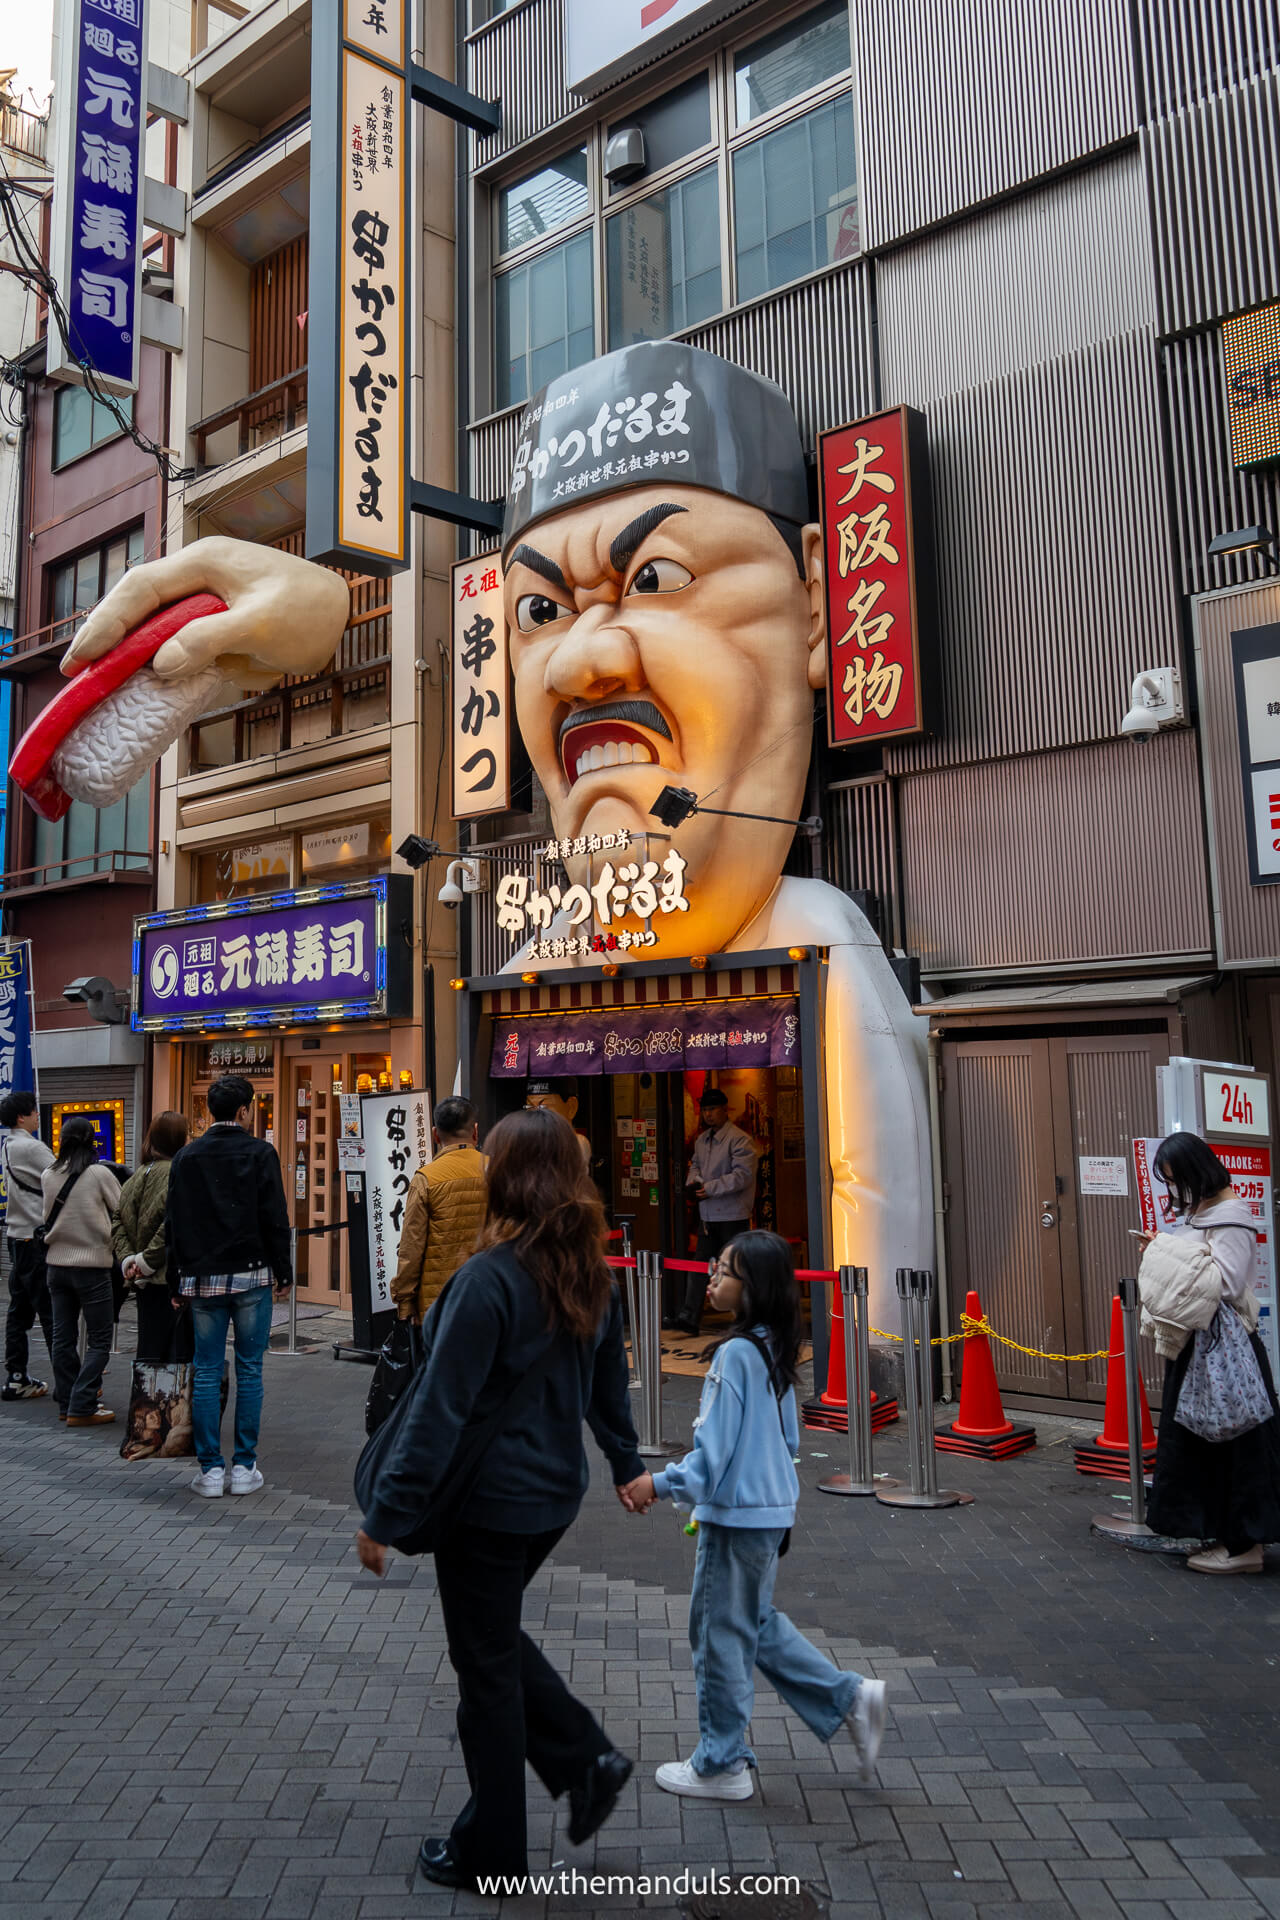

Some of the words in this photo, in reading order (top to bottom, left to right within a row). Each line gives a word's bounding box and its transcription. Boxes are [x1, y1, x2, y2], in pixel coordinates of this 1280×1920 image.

[86, 0, 136, 22] 祖
[362, 0, 388, 34] 年
[84, 22, 139, 66] 廻る
[365, 103, 379, 175] 大阪新世界
[380, 85, 394, 168] 創業昭和四年
[351, 125, 363, 191] 元祖串かつ
[78, 66, 136, 328] 元禄寿司
[349, 210, 398, 522] 串かつだるま
[510, 381, 692, 504] 串かつだるま
[551, 449, 690, 500] 大阪新世界元祖串かつ
[459, 567, 500, 601] 元祖
[836, 437, 904, 726] 大阪名物
[460, 613, 501, 793] 串かつ
[544, 828, 632, 861] 創業昭和四年
[496, 848, 690, 944] 串かつだるま
[186, 942, 212, 964] 元祖
[219, 919, 365, 992] 元禄寿司
[526, 929, 660, 960] 大阪新世界元祖串かつ
[183, 970, 215, 998] 廻る
[208, 1046, 267, 1065] お持ち帰り
[504, 1032, 519, 1069] 元祖
[535, 1039, 596, 1056] 創業昭和四年
[604, 1027, 682, 1061] 串かつだるま
[686, 1029, 768, 1048] 大阪新世界元祖串かつ
[1221, 1083, 1253, 1125] 24h
[413, 1103, 426, 1168] 創業昭和四年
[1216, 1154, 1252, 1169] ARAOKE
[1230, 1181, 1264, 1199] ャンカラ
[372, 1186, 386, 1300] 大阪新世界元祖串かつ
